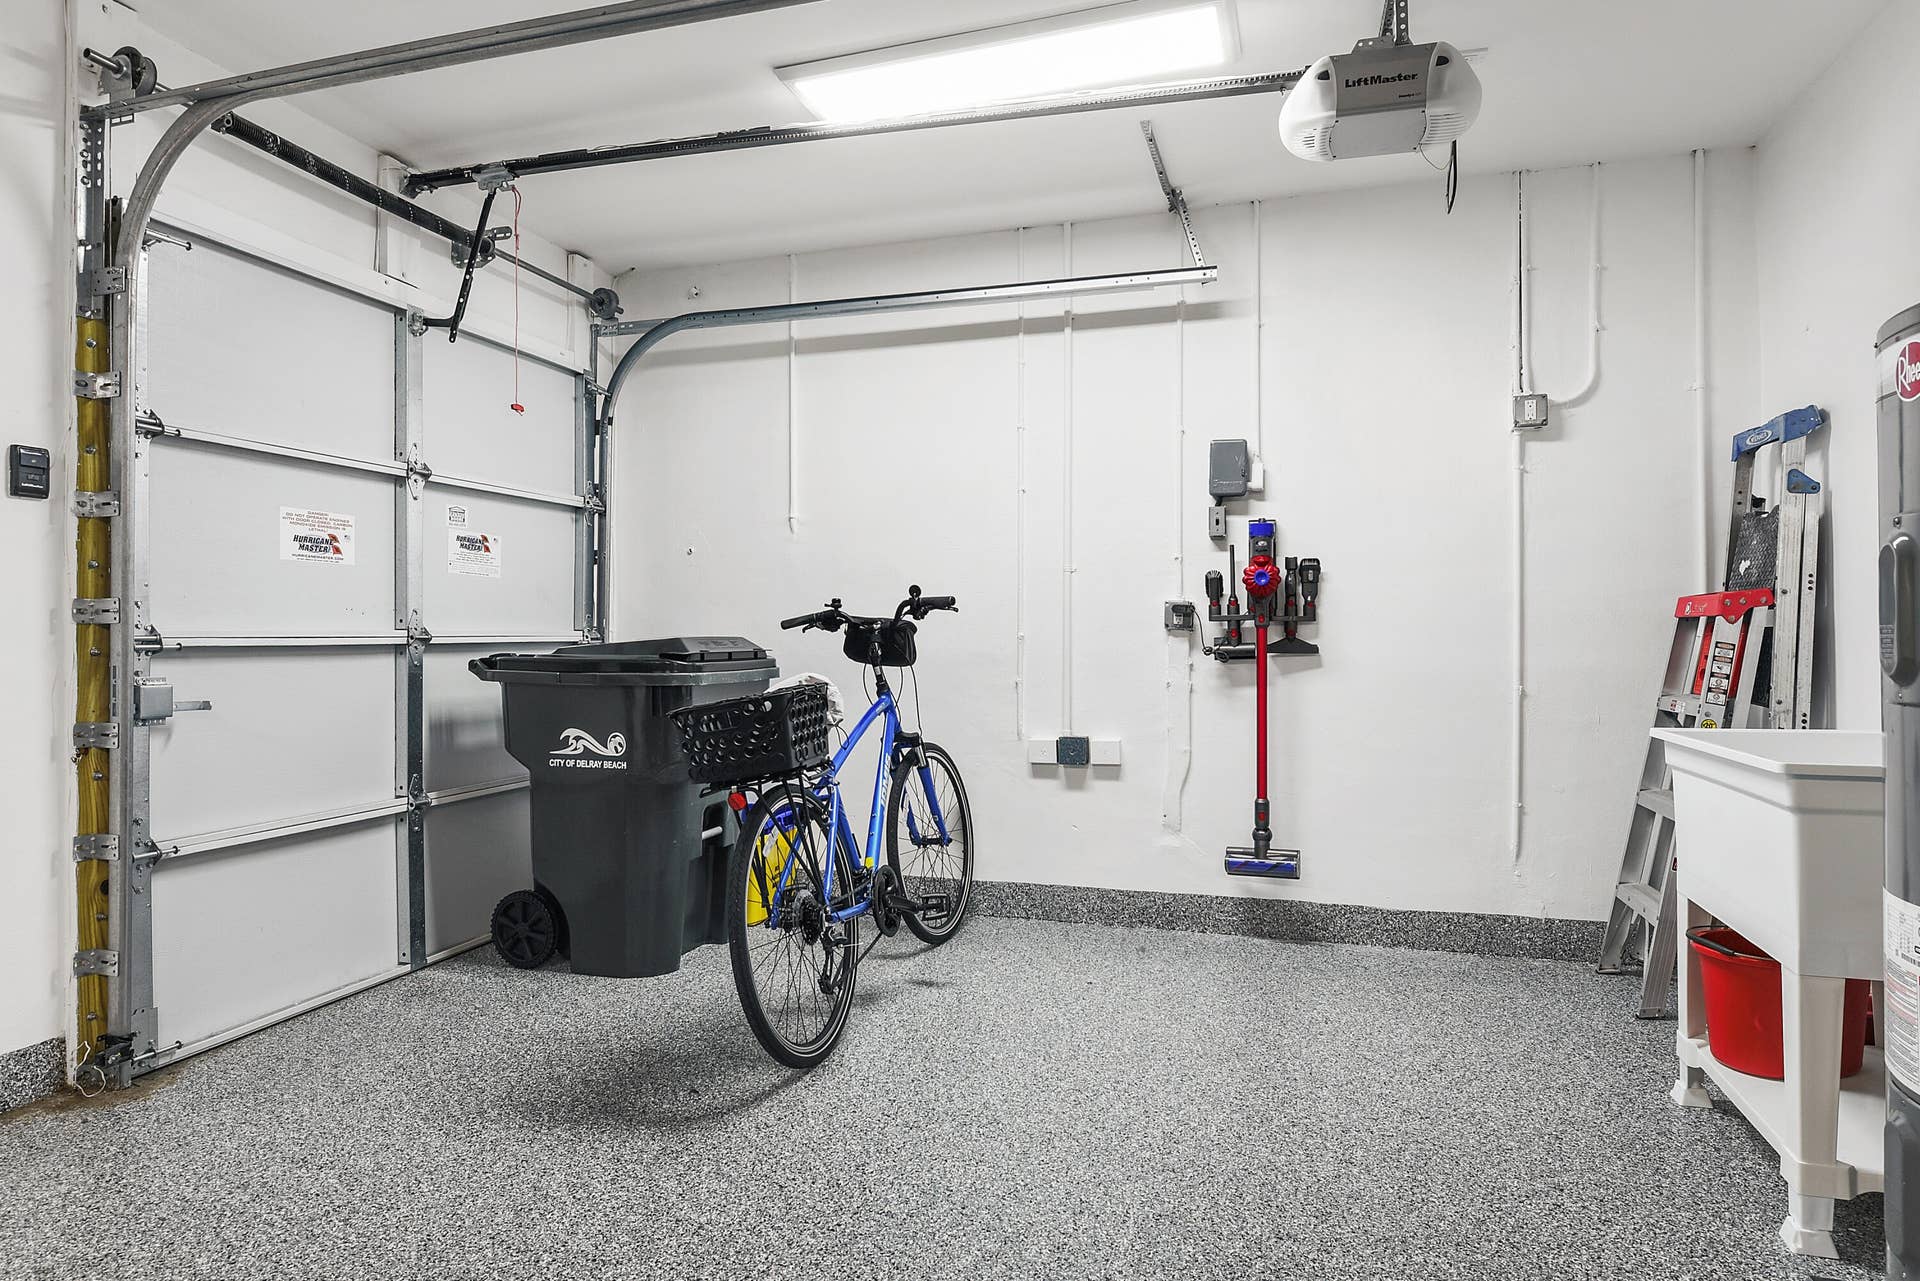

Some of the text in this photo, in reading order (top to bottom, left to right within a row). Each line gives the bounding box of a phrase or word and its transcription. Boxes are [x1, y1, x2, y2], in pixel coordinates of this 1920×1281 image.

[1345, 73, 1418, 88] LiftMaster
[293, 534, 334, 546] HURRICANE
[549, 759, 627, 769] CITY OF DELRAY BEACH
